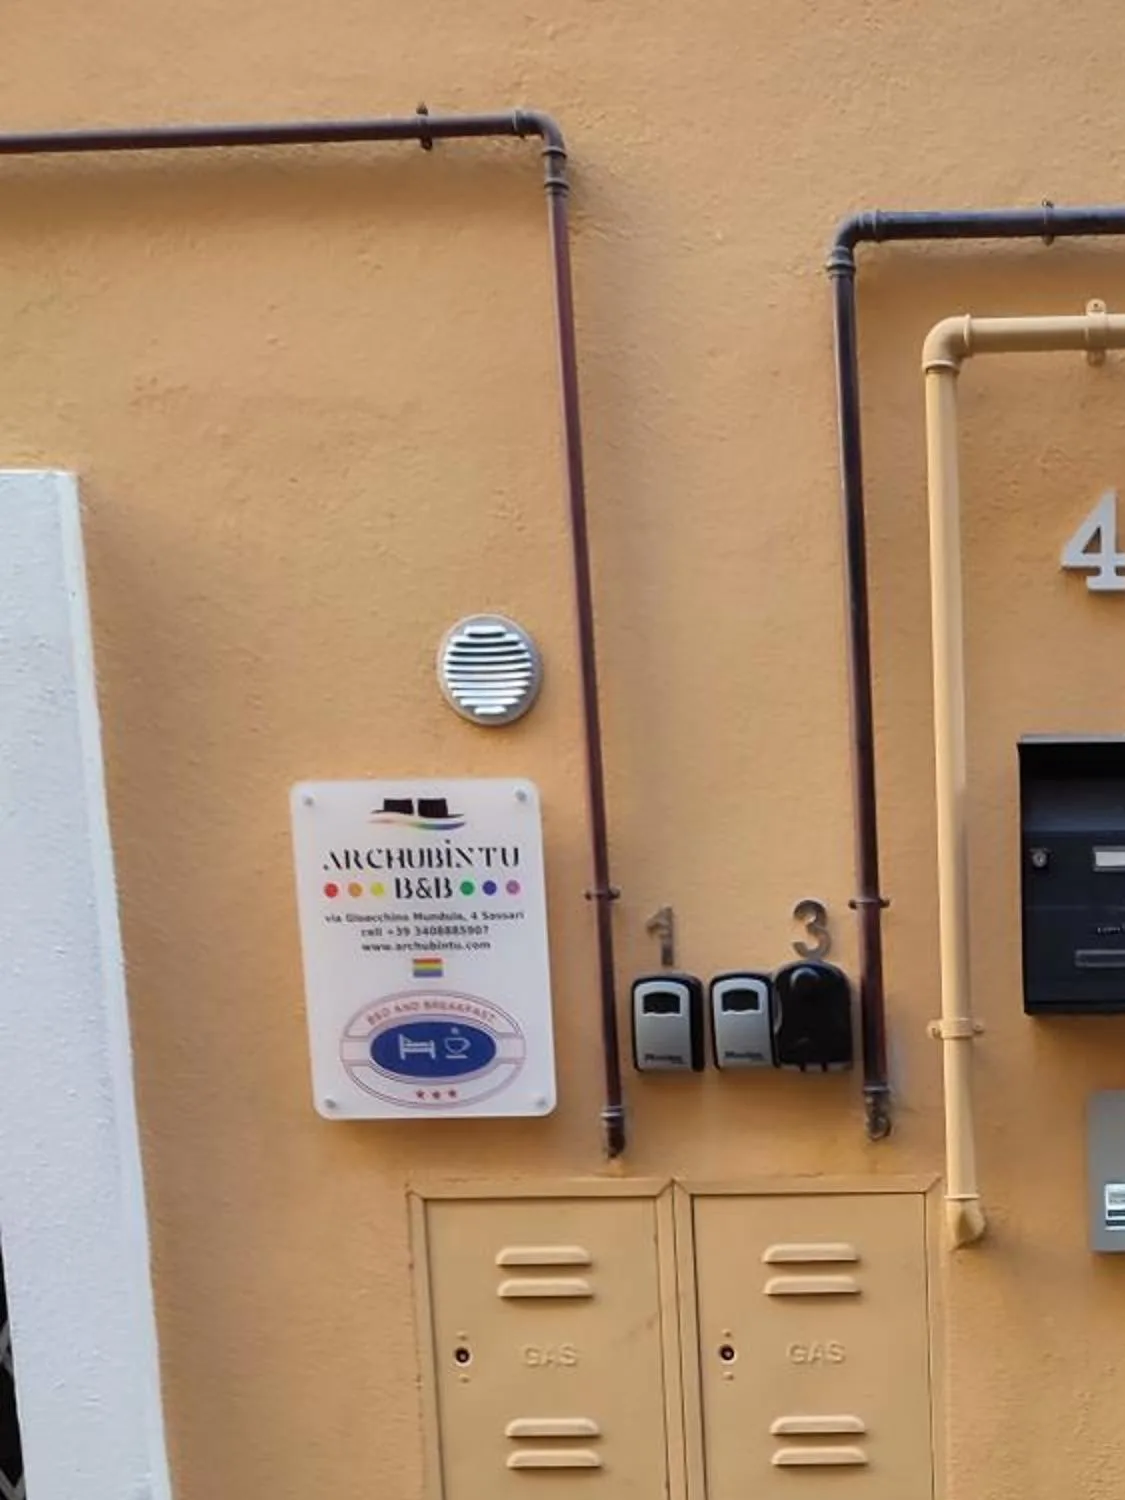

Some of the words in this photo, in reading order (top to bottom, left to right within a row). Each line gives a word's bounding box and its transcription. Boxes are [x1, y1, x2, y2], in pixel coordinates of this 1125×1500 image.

[394, 877, 453, 899] B&B
[324, 913, 342, 923] via
[791, 899, 831, 958] 3
[361, 927, 382, 937] cell
[387, 926, 411, 937] +39
[646, 906, 674, 966] 1
[523, 1344, 578, 1367] GAS
[788, 1341, 846, 1364] GAS
